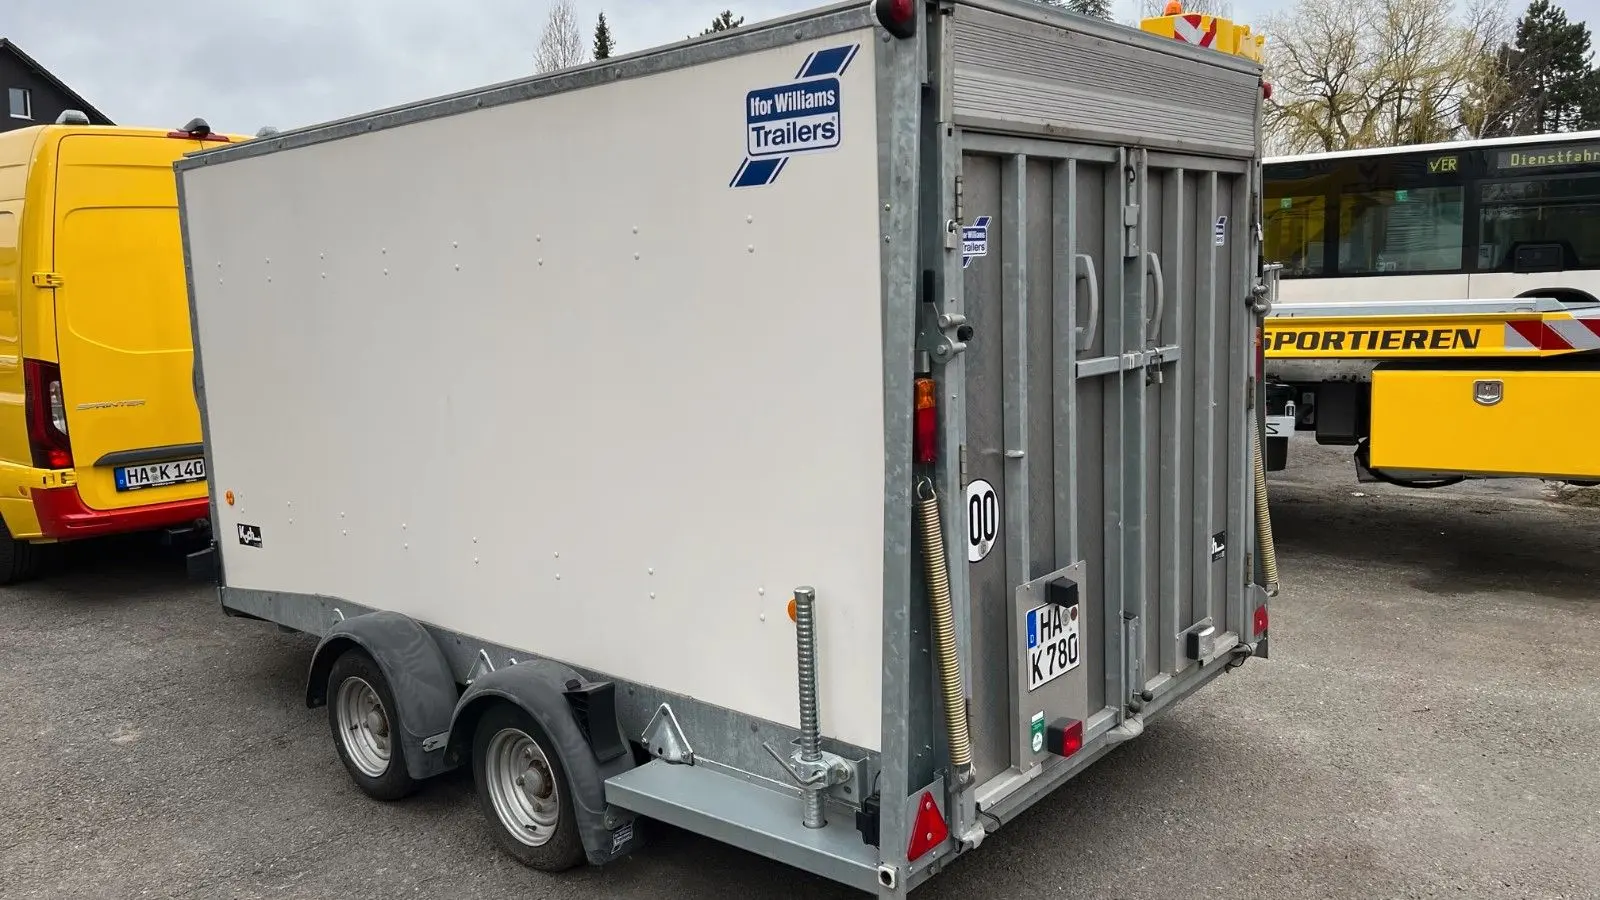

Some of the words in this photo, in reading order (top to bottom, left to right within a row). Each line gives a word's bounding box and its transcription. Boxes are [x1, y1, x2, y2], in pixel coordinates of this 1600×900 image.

[750, 98, 773, 117] Ifor
[774, 89, 836, 113] Williams
[751, 121, 836, 148] Trailers
[127, 467, 151, 485] HA
[159, 465, 171, 480] K
[174, 460, 204, 479] 140
[1040, 604, 1063, 644] HA
[1032, 649, 1044, 685] K
[1046, 632, 1078, 676] 780
